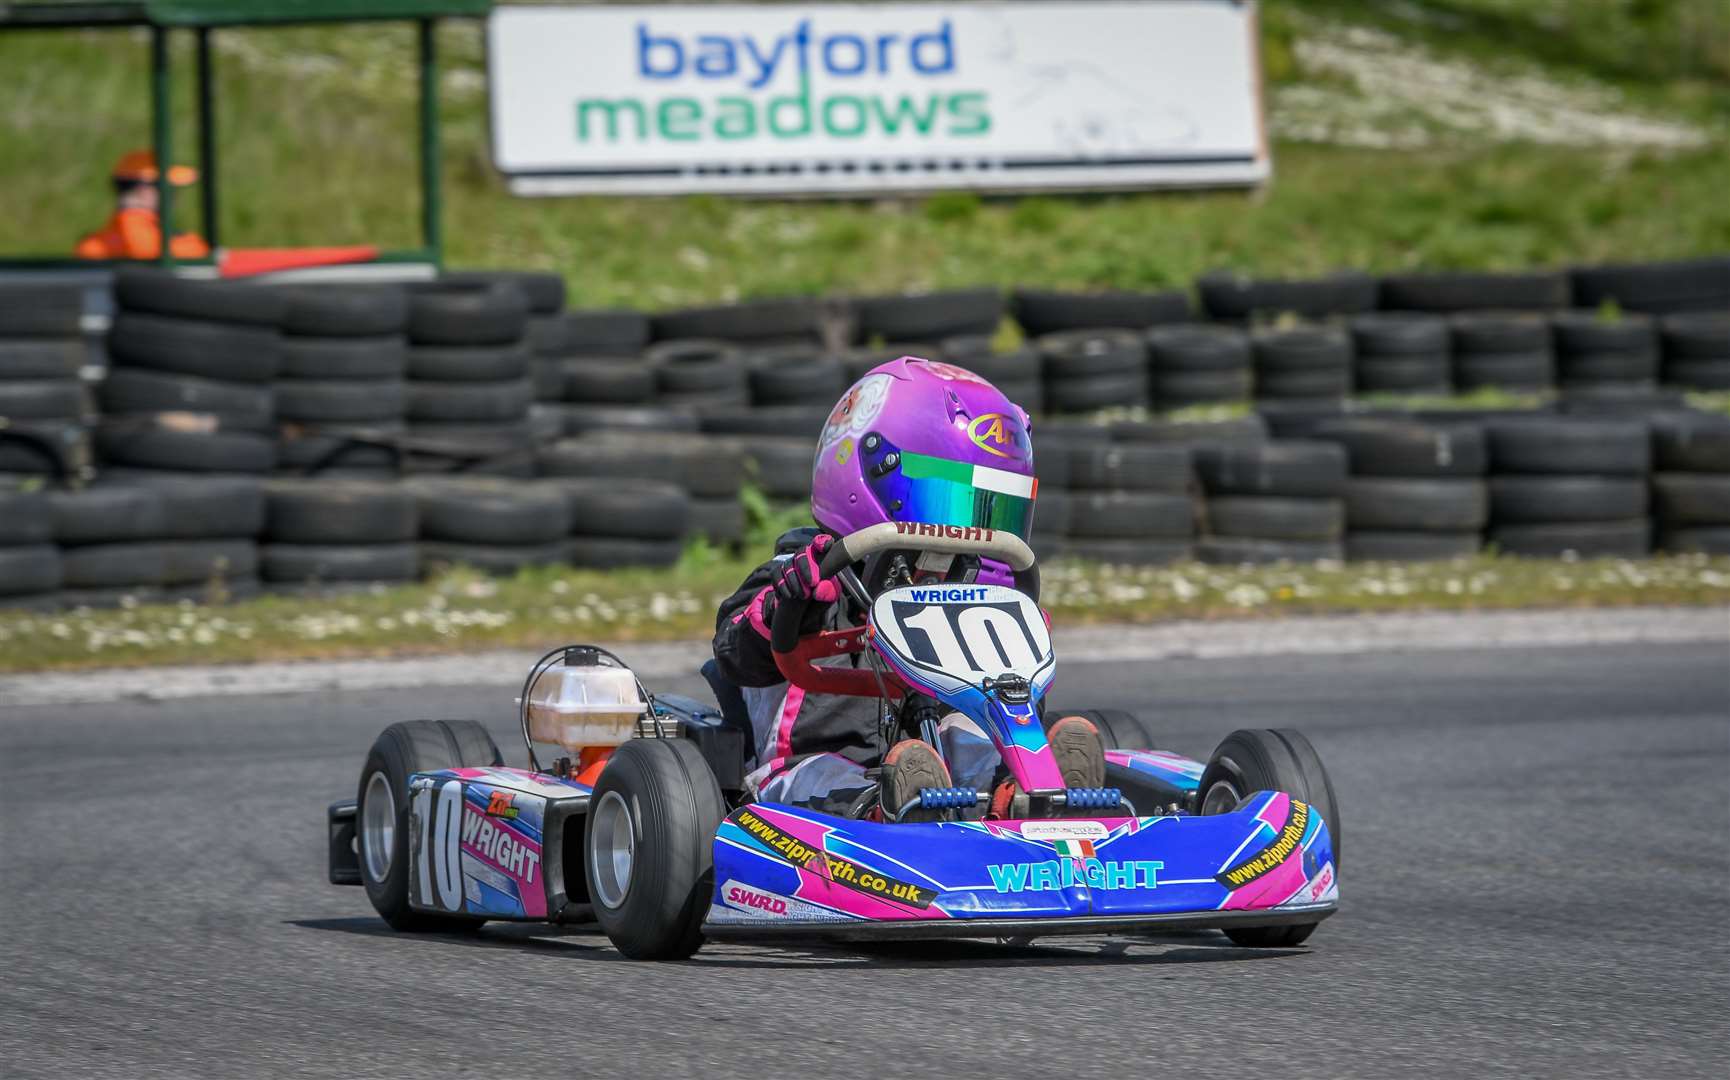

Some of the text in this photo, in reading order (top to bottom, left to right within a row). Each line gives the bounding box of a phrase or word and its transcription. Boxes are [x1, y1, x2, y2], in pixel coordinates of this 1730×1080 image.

[634, 19, 957, 89] bayford
[575, 75, 994, 141] meadows
[894, 522, 996, 542] WRIGHT
[910, 588, 988, 602] WRIGHT
[903, 605, 1042, 673] 10
[410, 778, 463, 912] 10
[462, 809, 540, 884] WRIGHT
[737, 811, 922, 903] www.zipnrth.co.uk
[987, 856, 1165, 894] WRIGHT
[1226, 799, 1308, 885] www.zipnorth.co.uk
